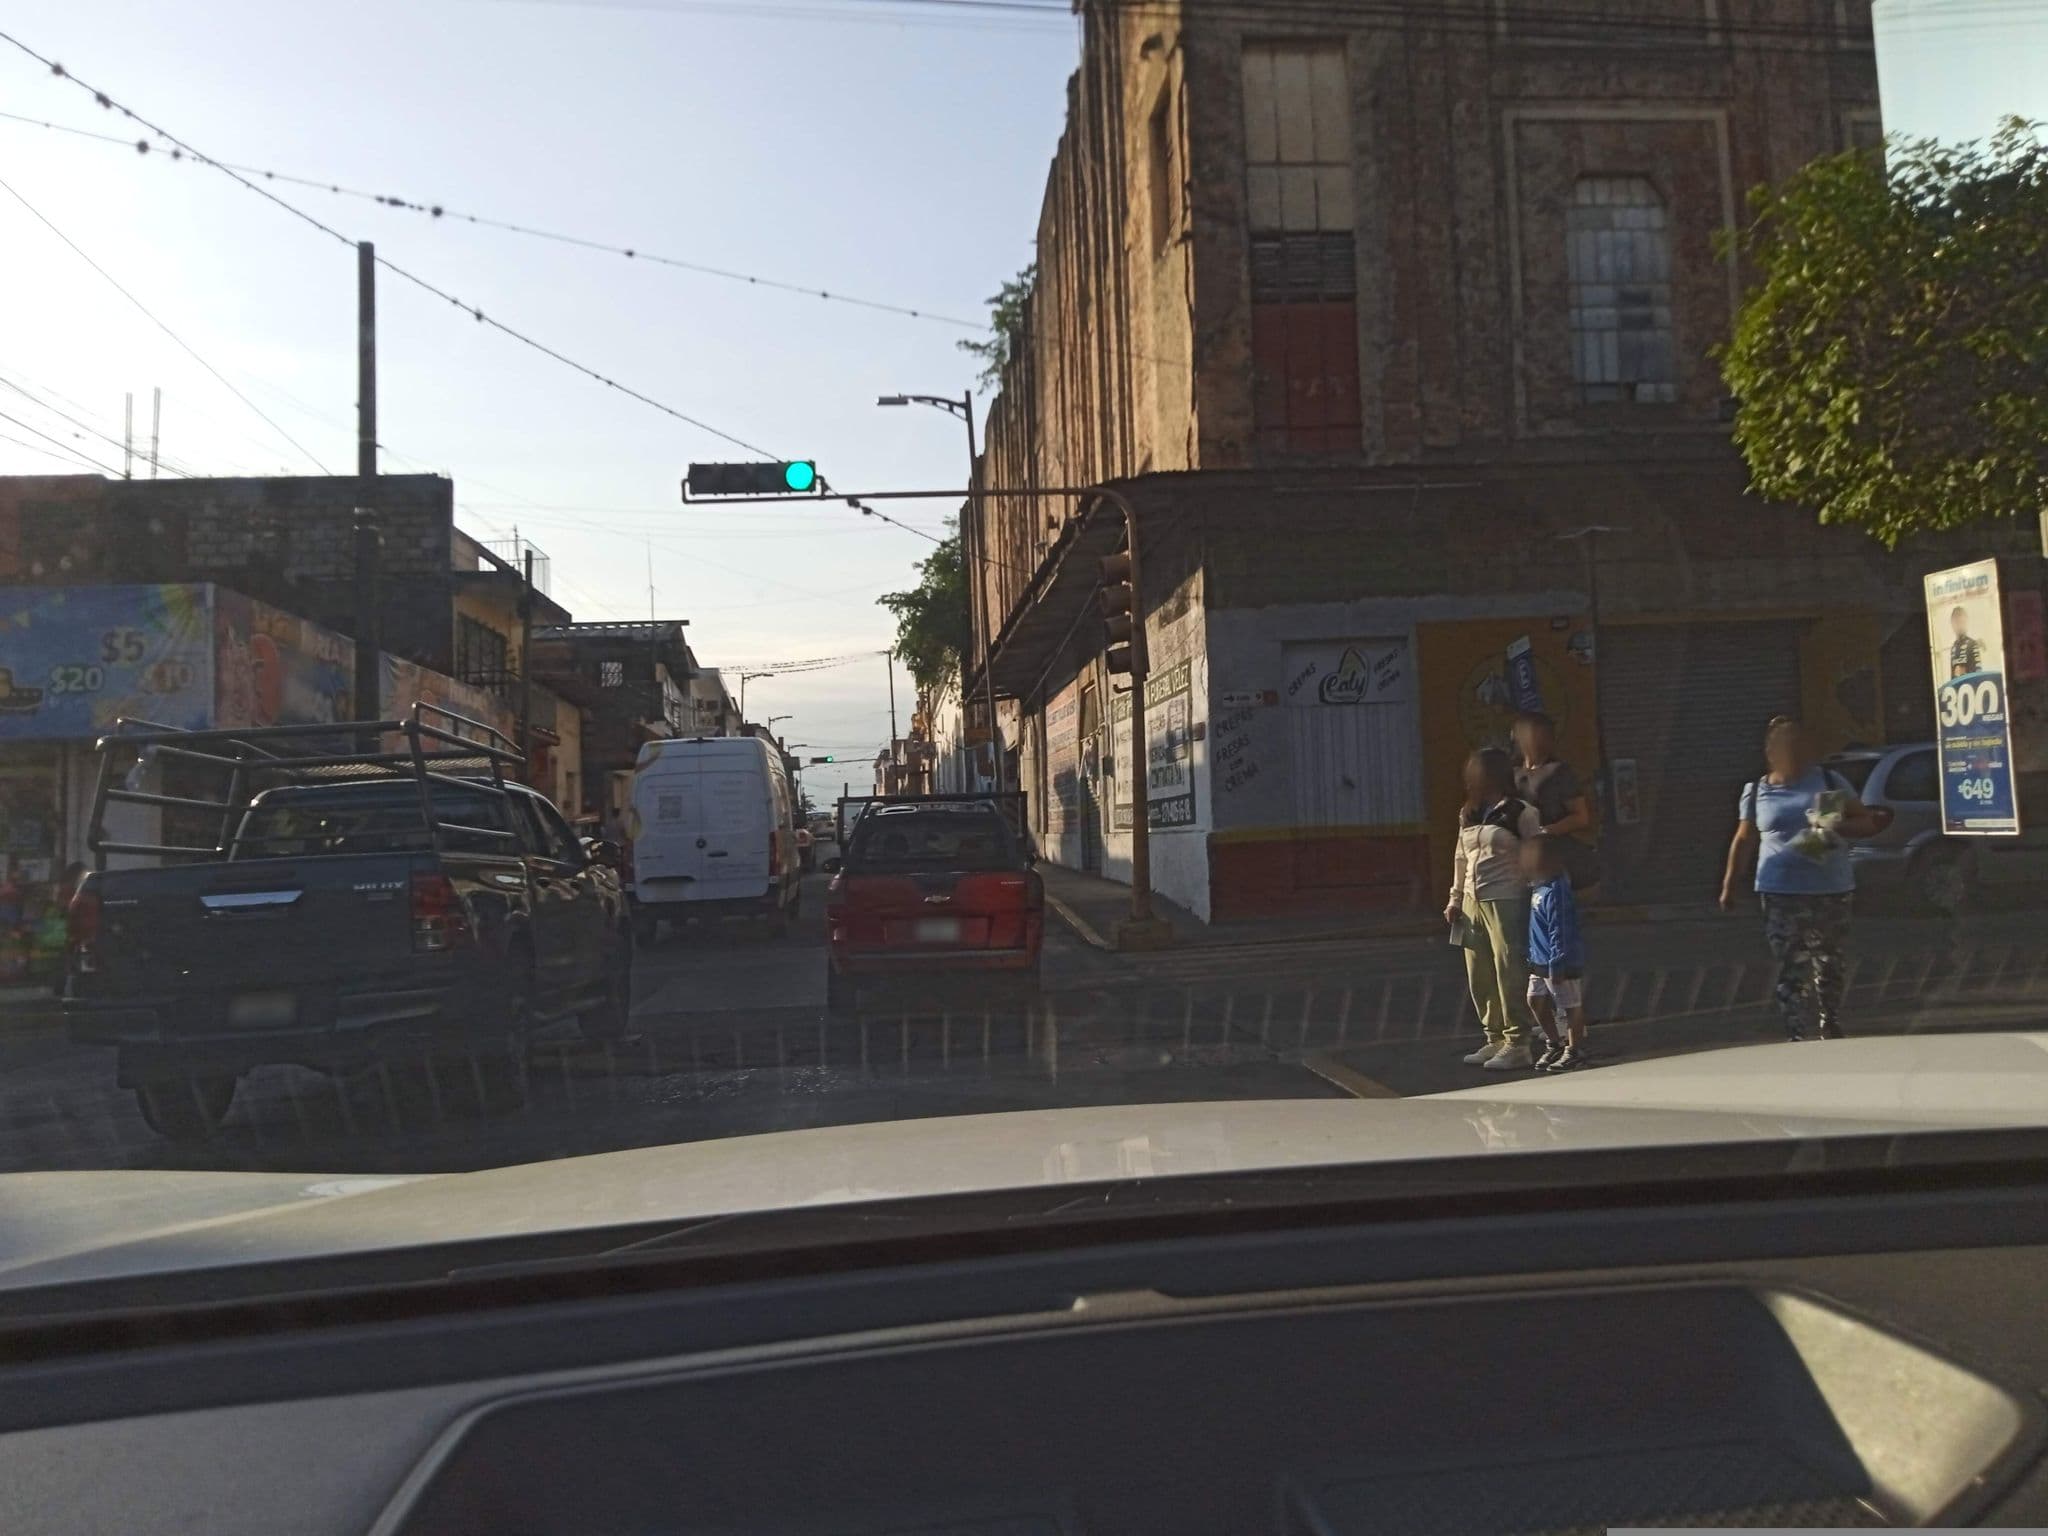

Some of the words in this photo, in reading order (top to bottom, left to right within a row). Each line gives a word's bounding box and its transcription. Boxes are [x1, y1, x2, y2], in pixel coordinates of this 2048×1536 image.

[101, 631, 145, 664] $5
[50, 665, 105, 695] $20
[1941, 681, 1997, 727] 300
